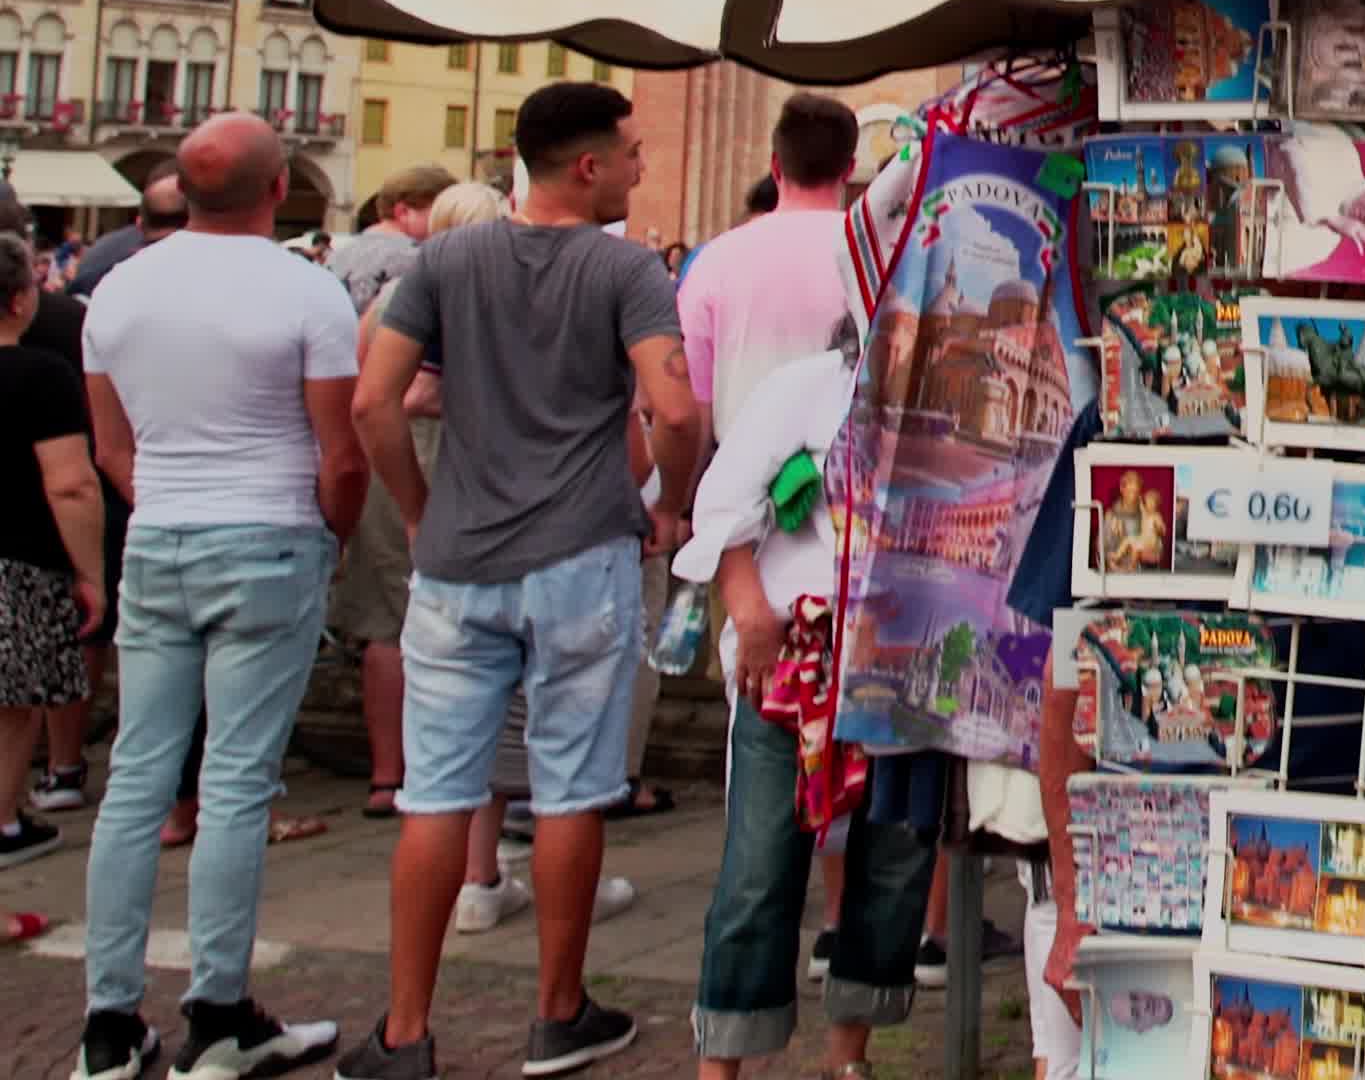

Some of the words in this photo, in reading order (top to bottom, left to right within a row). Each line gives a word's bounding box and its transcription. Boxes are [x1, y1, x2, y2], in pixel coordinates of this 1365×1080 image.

[947, 182, 1042, 219] PADOVA
[1206, 487, 1232, 520] €
[1199, 628, 1252, 648] PADOVA
